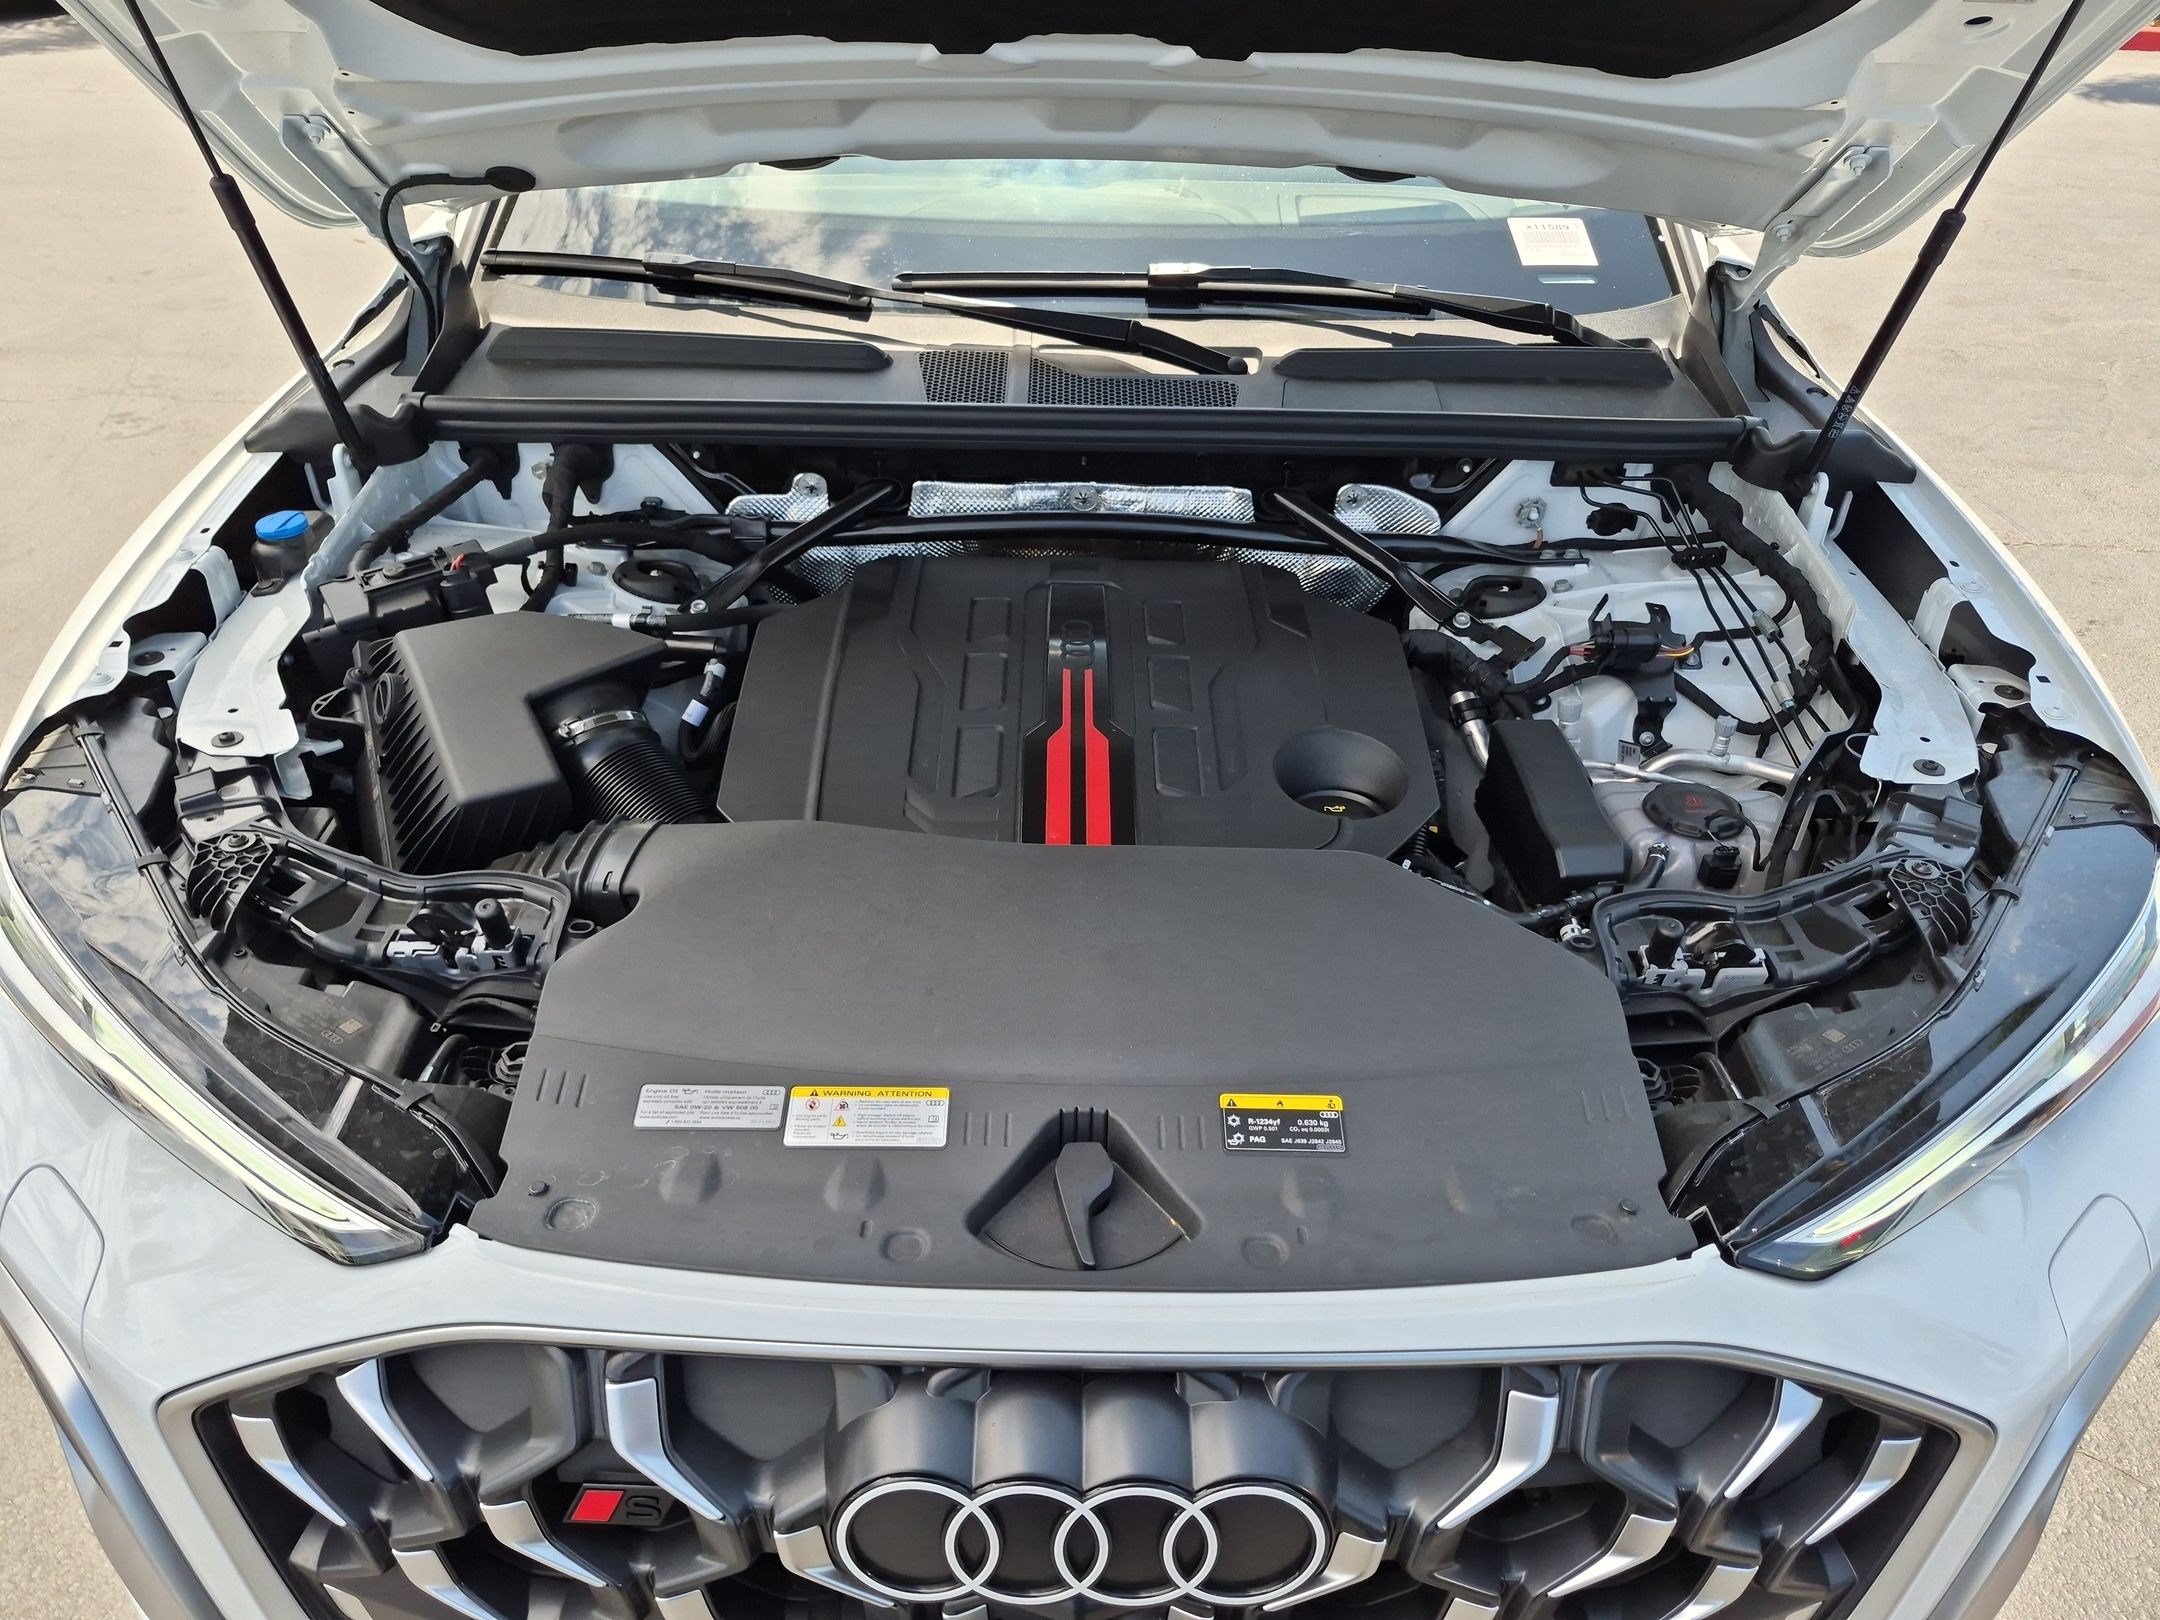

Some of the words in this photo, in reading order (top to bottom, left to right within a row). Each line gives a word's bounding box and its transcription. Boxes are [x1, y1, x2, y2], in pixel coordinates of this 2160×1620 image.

[1248, 1118, 1280, 1126] R-1234yf
[1319, 1119, 1329, 1128] kg
[1249, 1135, 1266, 1143] PAG
[626, 1495, 662, 1520] S
